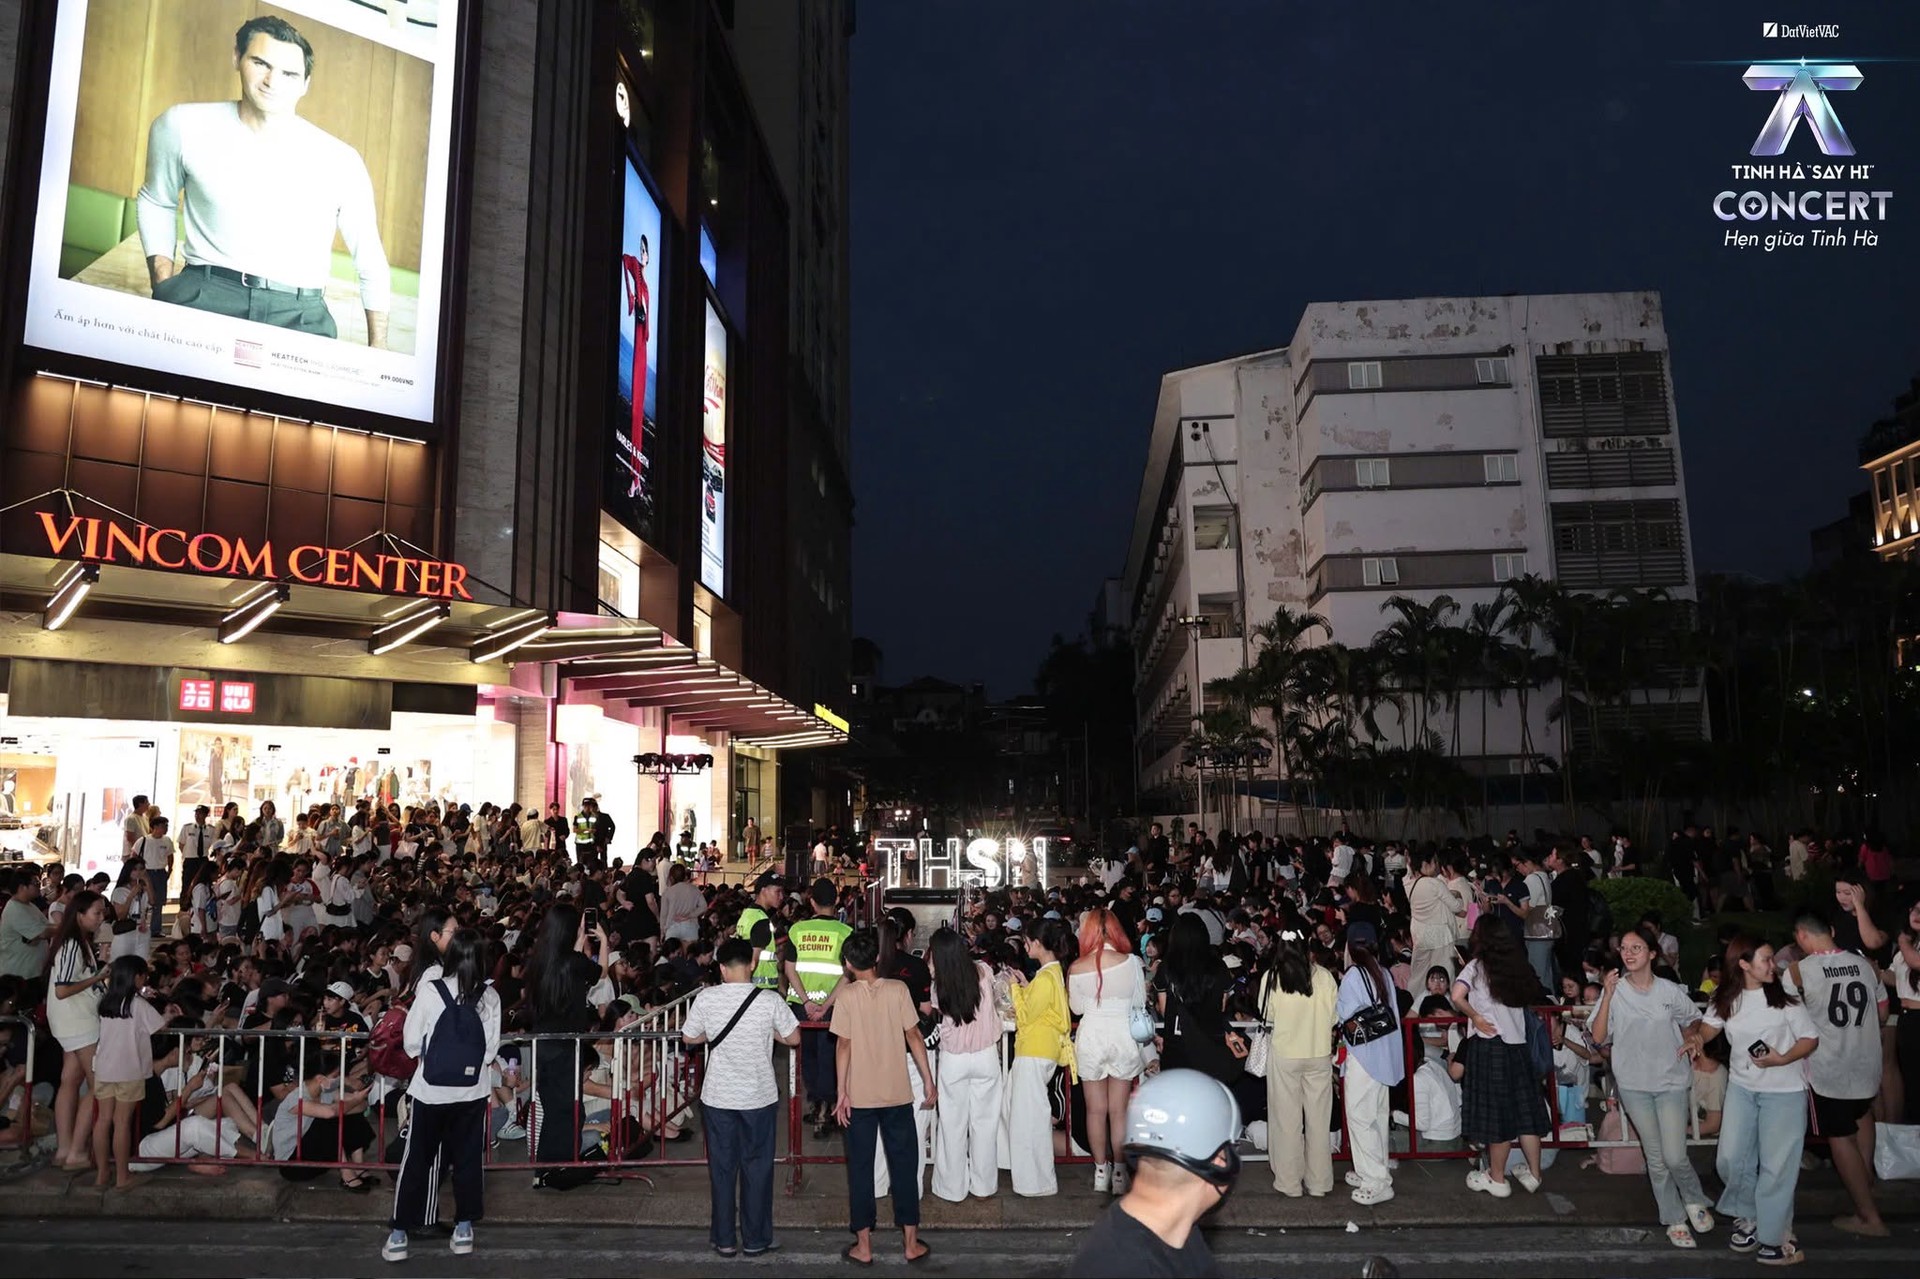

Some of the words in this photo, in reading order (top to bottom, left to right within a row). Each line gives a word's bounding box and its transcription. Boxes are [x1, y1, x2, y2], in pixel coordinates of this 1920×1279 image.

[271, 352, 309, 365] HEATTECH
[35, 511, 279, 579] VINCOM
[288, 545, 474, 601] CENTER
[224, 685, 250, 697] UNI
[223, 697, 251, 710] QLO
[819, 935, 830, 943] AN
[799, 943, 833, 952] SECURITY
[1828, 981, 1868, 1028] 69
